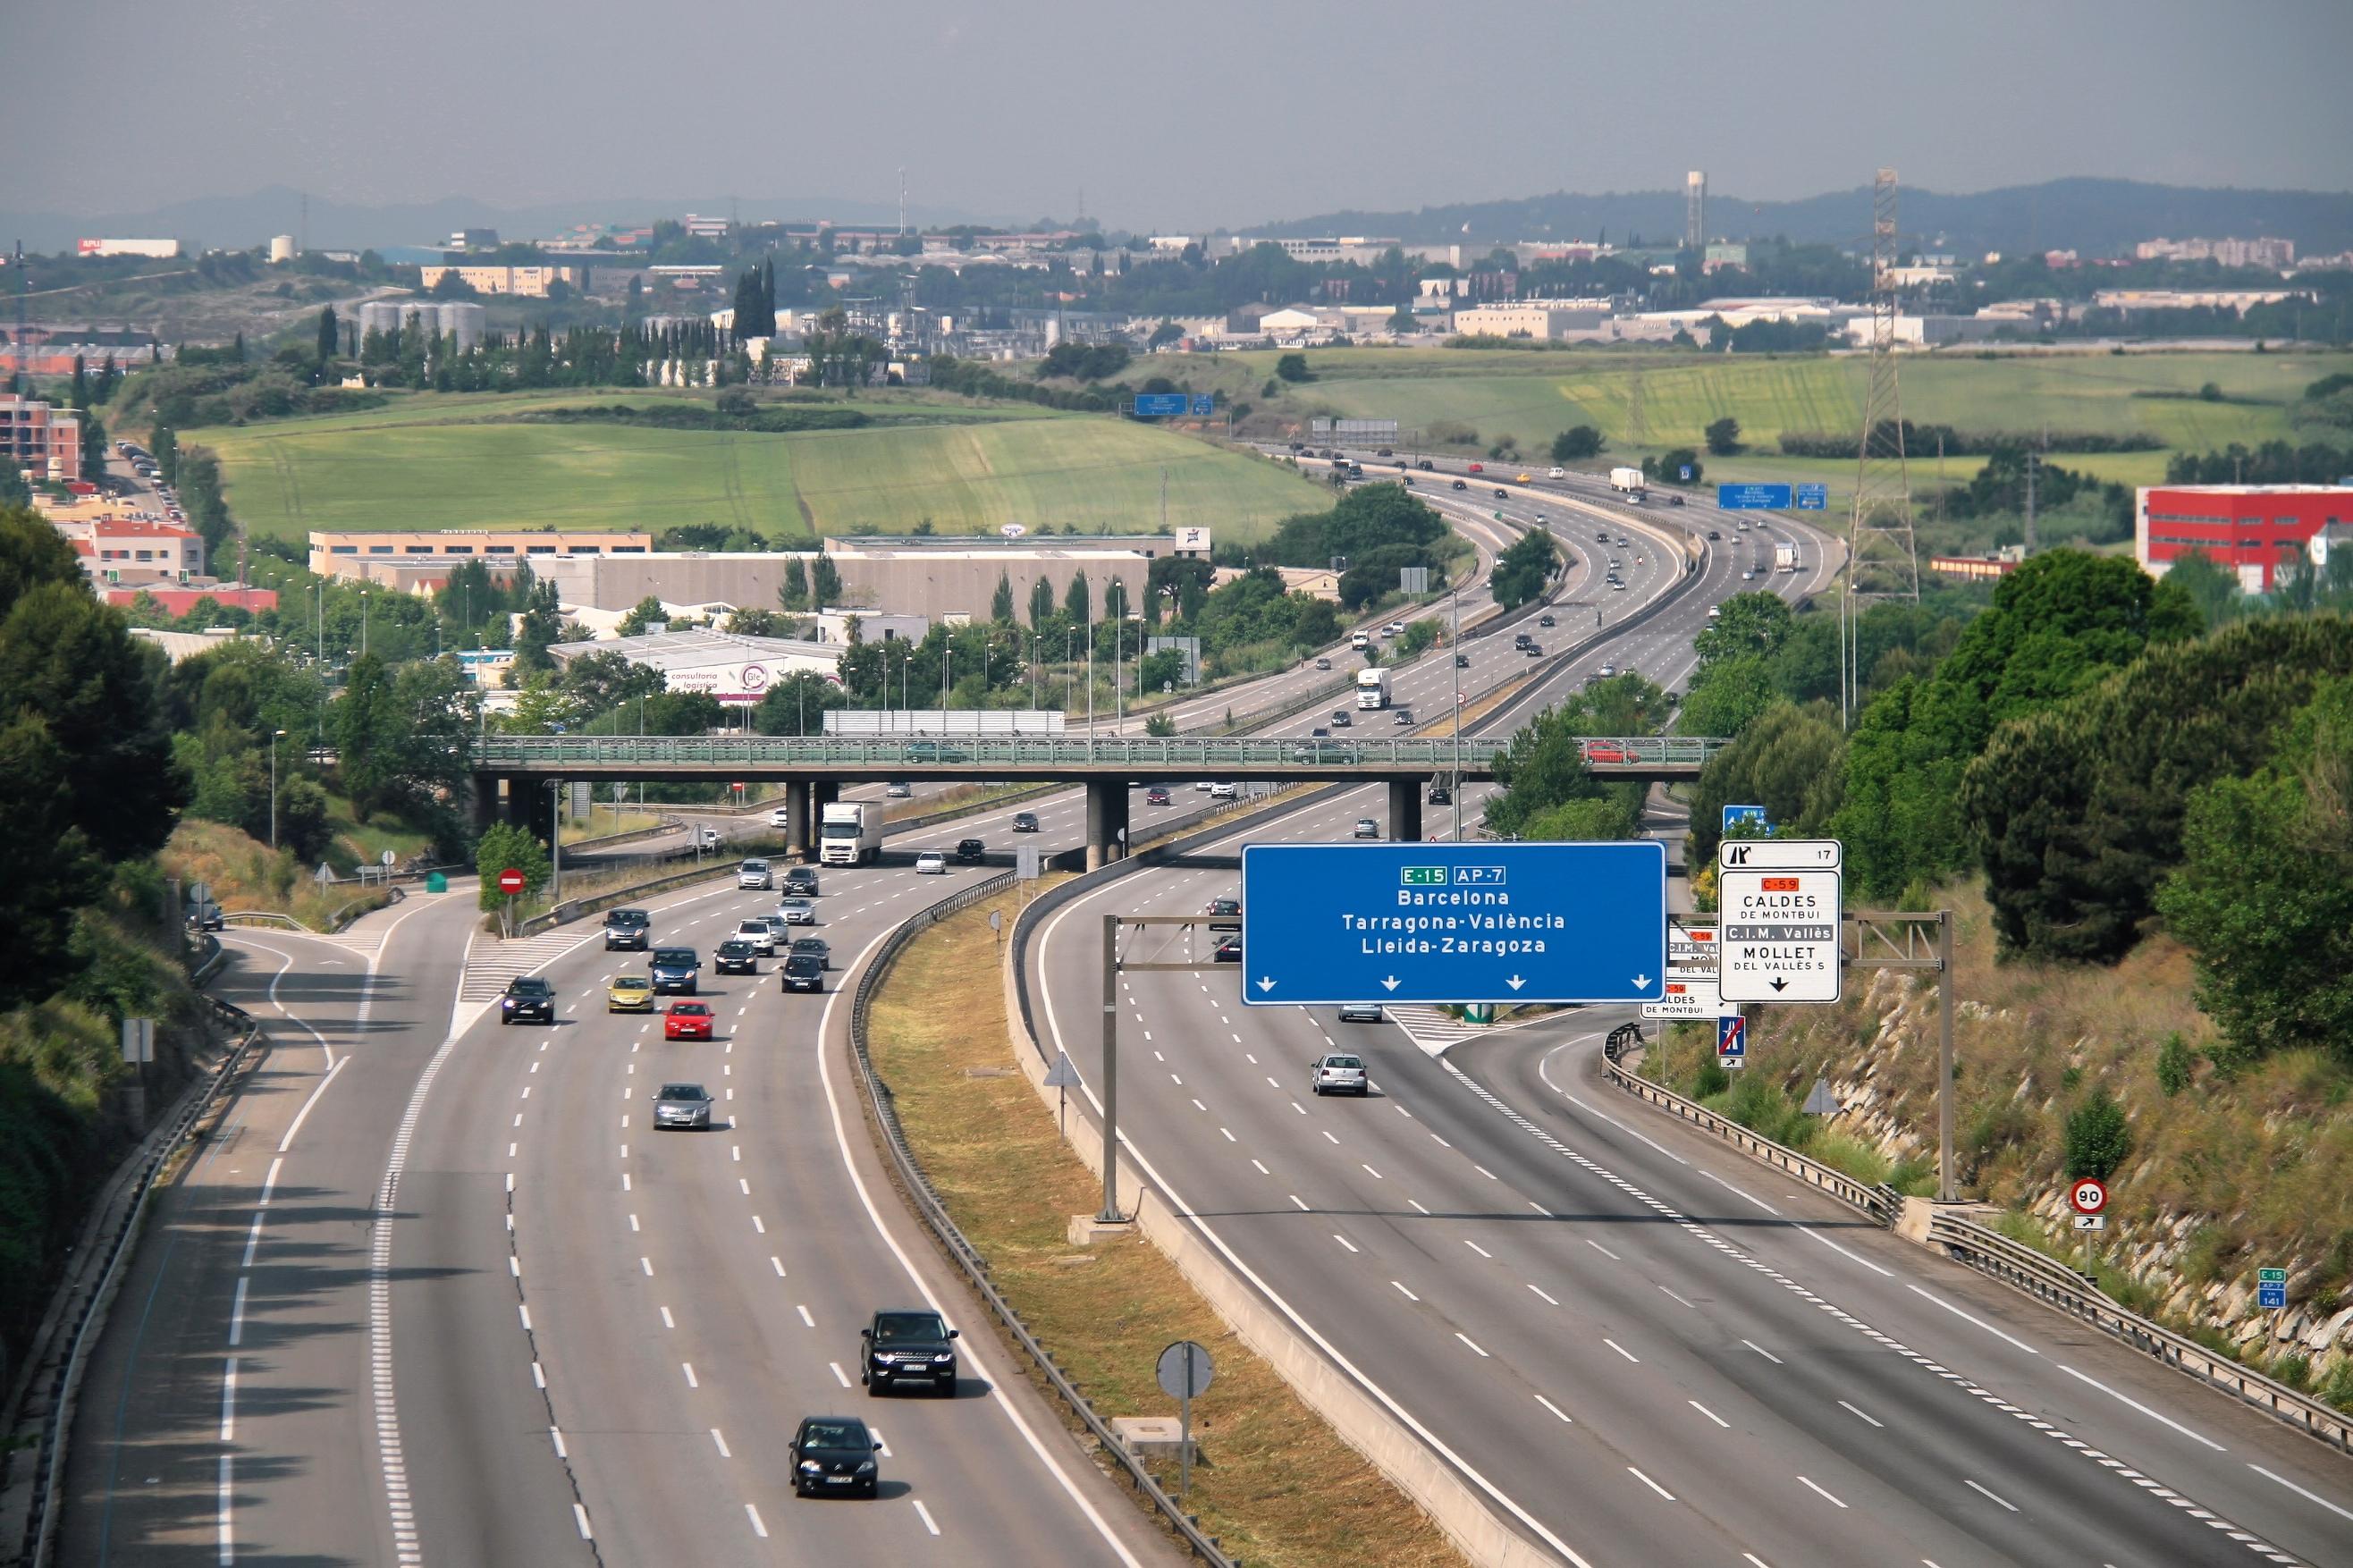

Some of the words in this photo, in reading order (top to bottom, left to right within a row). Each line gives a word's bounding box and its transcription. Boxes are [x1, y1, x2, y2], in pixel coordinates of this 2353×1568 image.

[1818, 850, 1831, 859] 17
[1404, 870, 1445, 882] E-15
[1457, 869, 1503, 882] AP-7
[1763, 881, 1797, 889] C-59
[1398, 890, 1509, 906] Barcelona
[1743, 896, 1816, 907] CALDES
[1741, 911, 1757, 919] DE
[1762, 911, 1819, 919] MONTBUI
[1342, 913, 1564, 934] Tarragona-València
[1729, 927, 1775, 939] C.I.M.
[1784, 926, 1831, 939] Vallès
[1362, 937, 1546, 957] Lleida-Zaragoza
[1744, 948, 1816, 959] MOLLET
[1734, 962, 1758, 971] DEL
[1817, 962, 1825, 971] S
[1666, 996, 1696, 1004] LDES
[2079, 1190, 2099, 1202] 90
[2261, 1270, 2283, 1279] E-15
